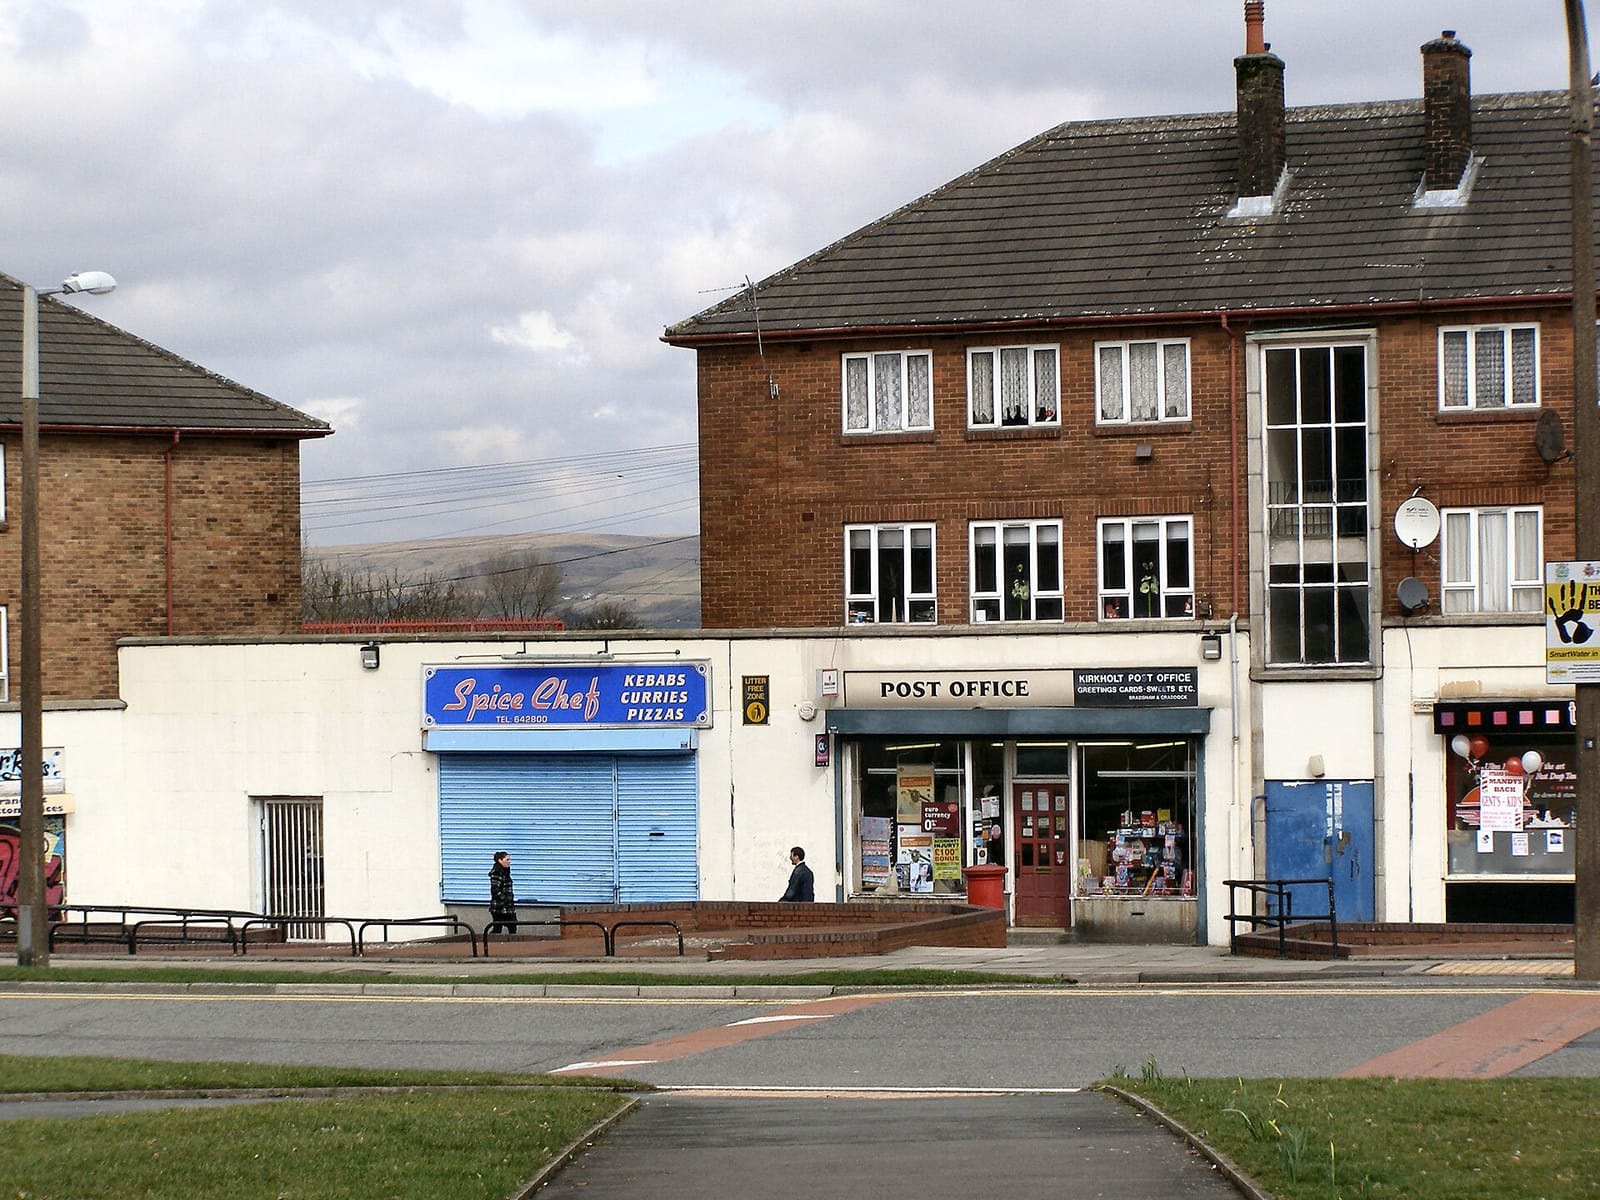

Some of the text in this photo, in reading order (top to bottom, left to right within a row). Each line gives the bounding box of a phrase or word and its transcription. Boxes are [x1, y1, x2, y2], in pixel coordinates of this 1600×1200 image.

[624, 674, 685, 687] KEBABS
[1079, 673, 1191, 683] KIRKHOLT POST OFFICE
[881, 680, 1029, 697] POST OFFICE
[443, 676, 600, 721] Spice Chef
[620, 690, 688, 704] CURRIES
[514, 715, 548, 723] 642800
[627, 707, 684, 721] PIZZAS
